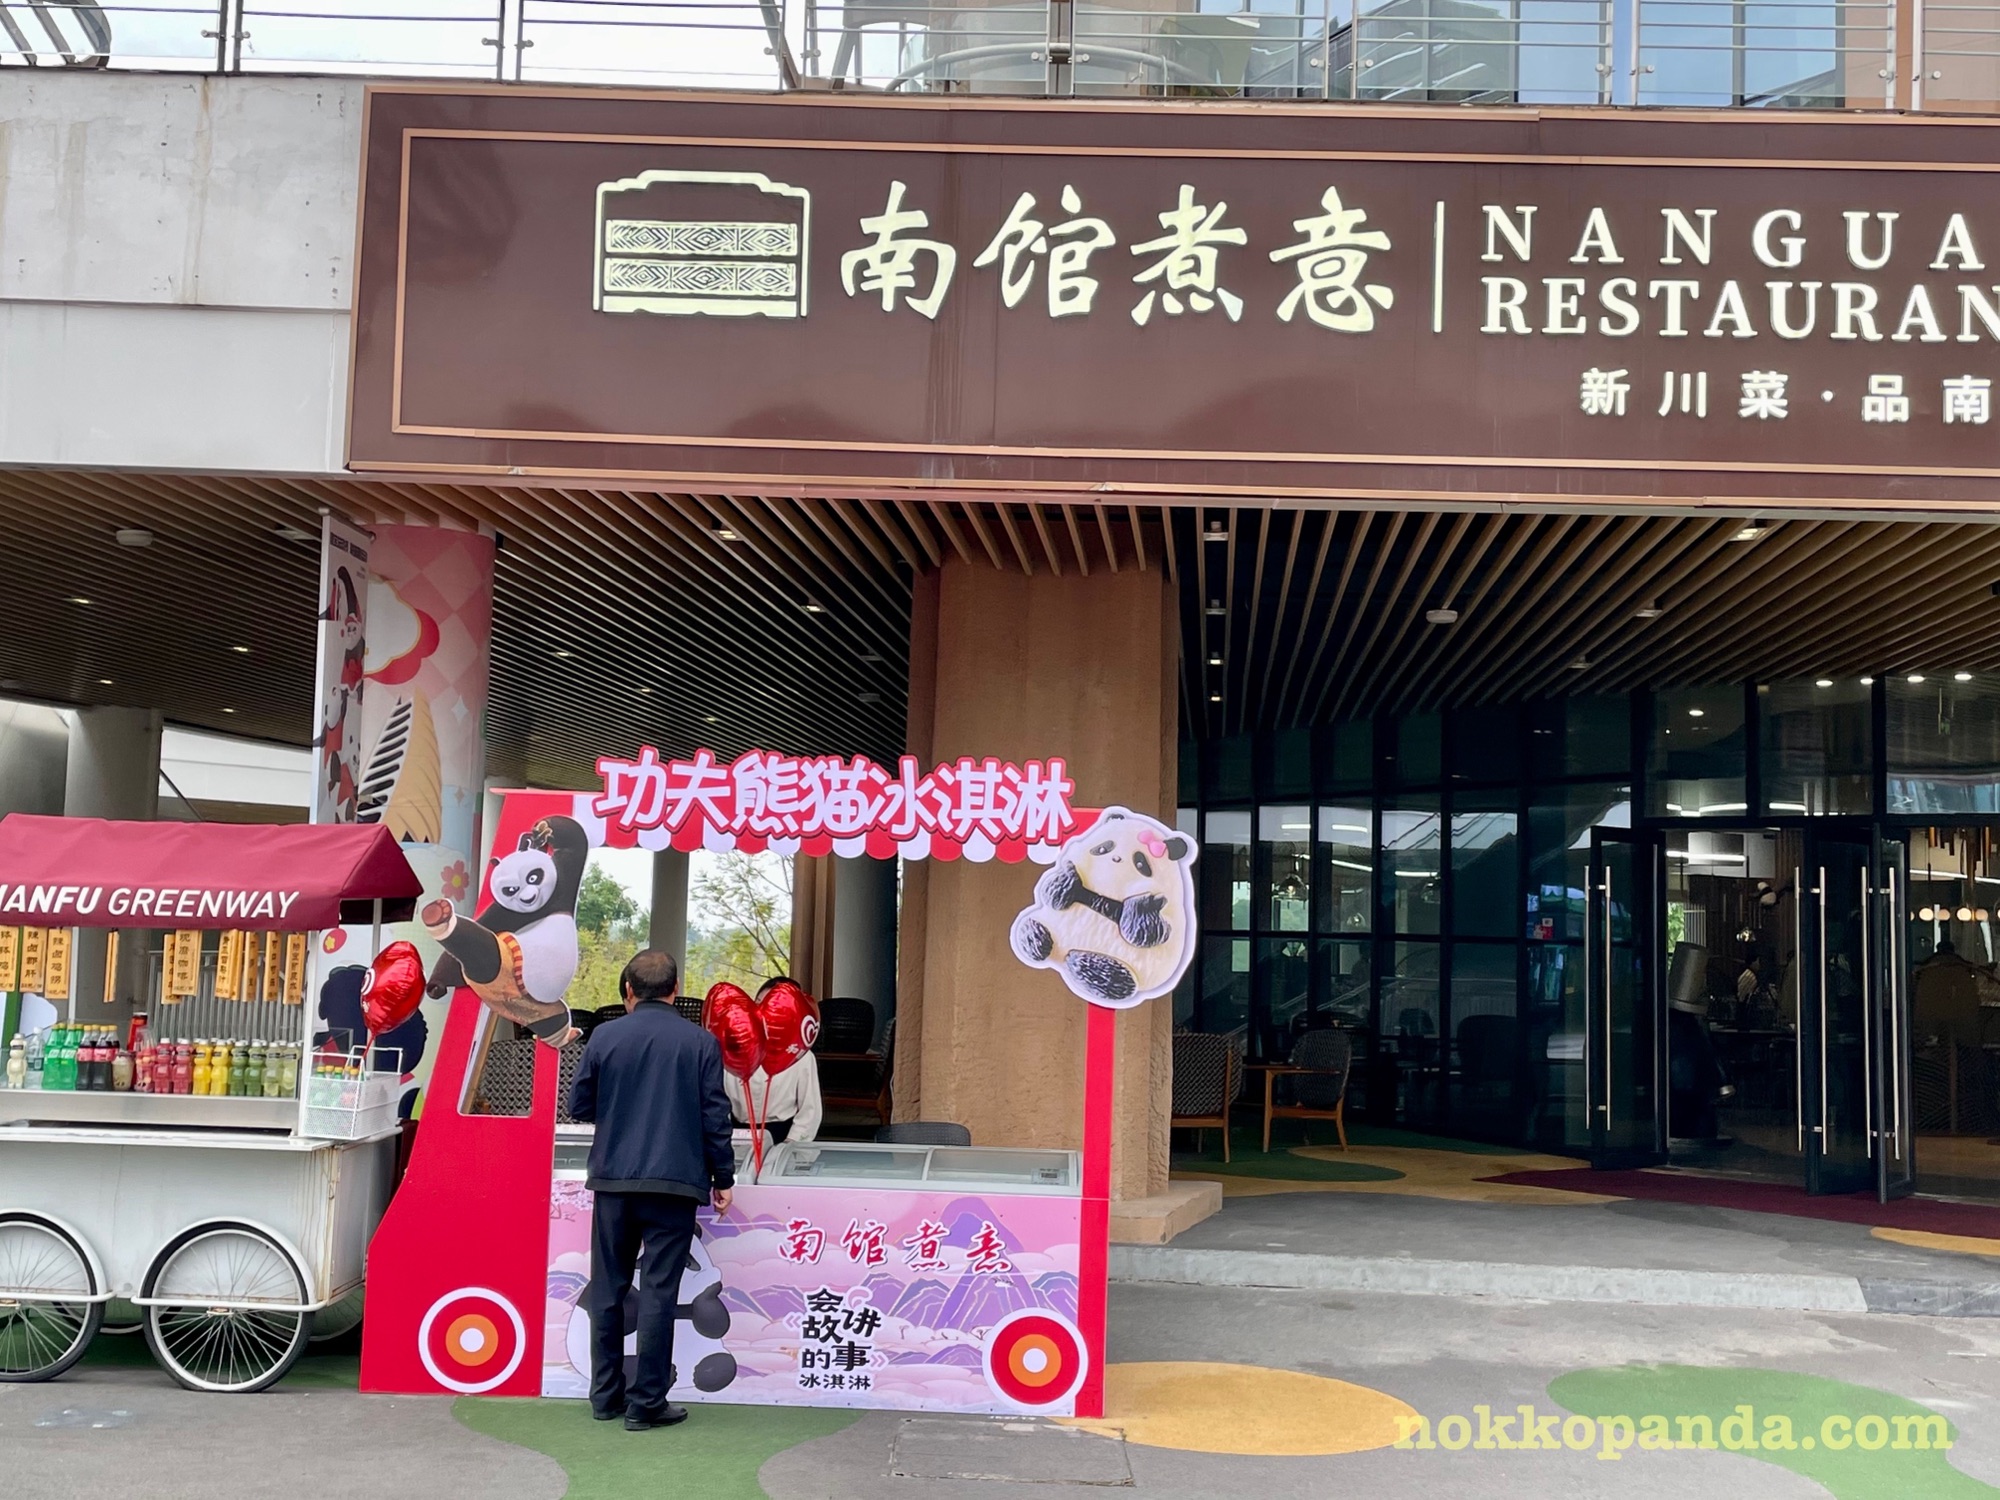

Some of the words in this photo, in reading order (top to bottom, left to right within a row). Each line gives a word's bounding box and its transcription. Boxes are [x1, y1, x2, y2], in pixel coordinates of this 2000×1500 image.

[841, 181, 1393, 333] 南馆煮意
[1480, 204, 1985, 271] NANGUA
[596, 748, 1075, 841] 功夫熊猫冰淇淋
[108, 887, 299, 918] GREENWAY
[799, 1373, 871, 1390] 冰淇淋
